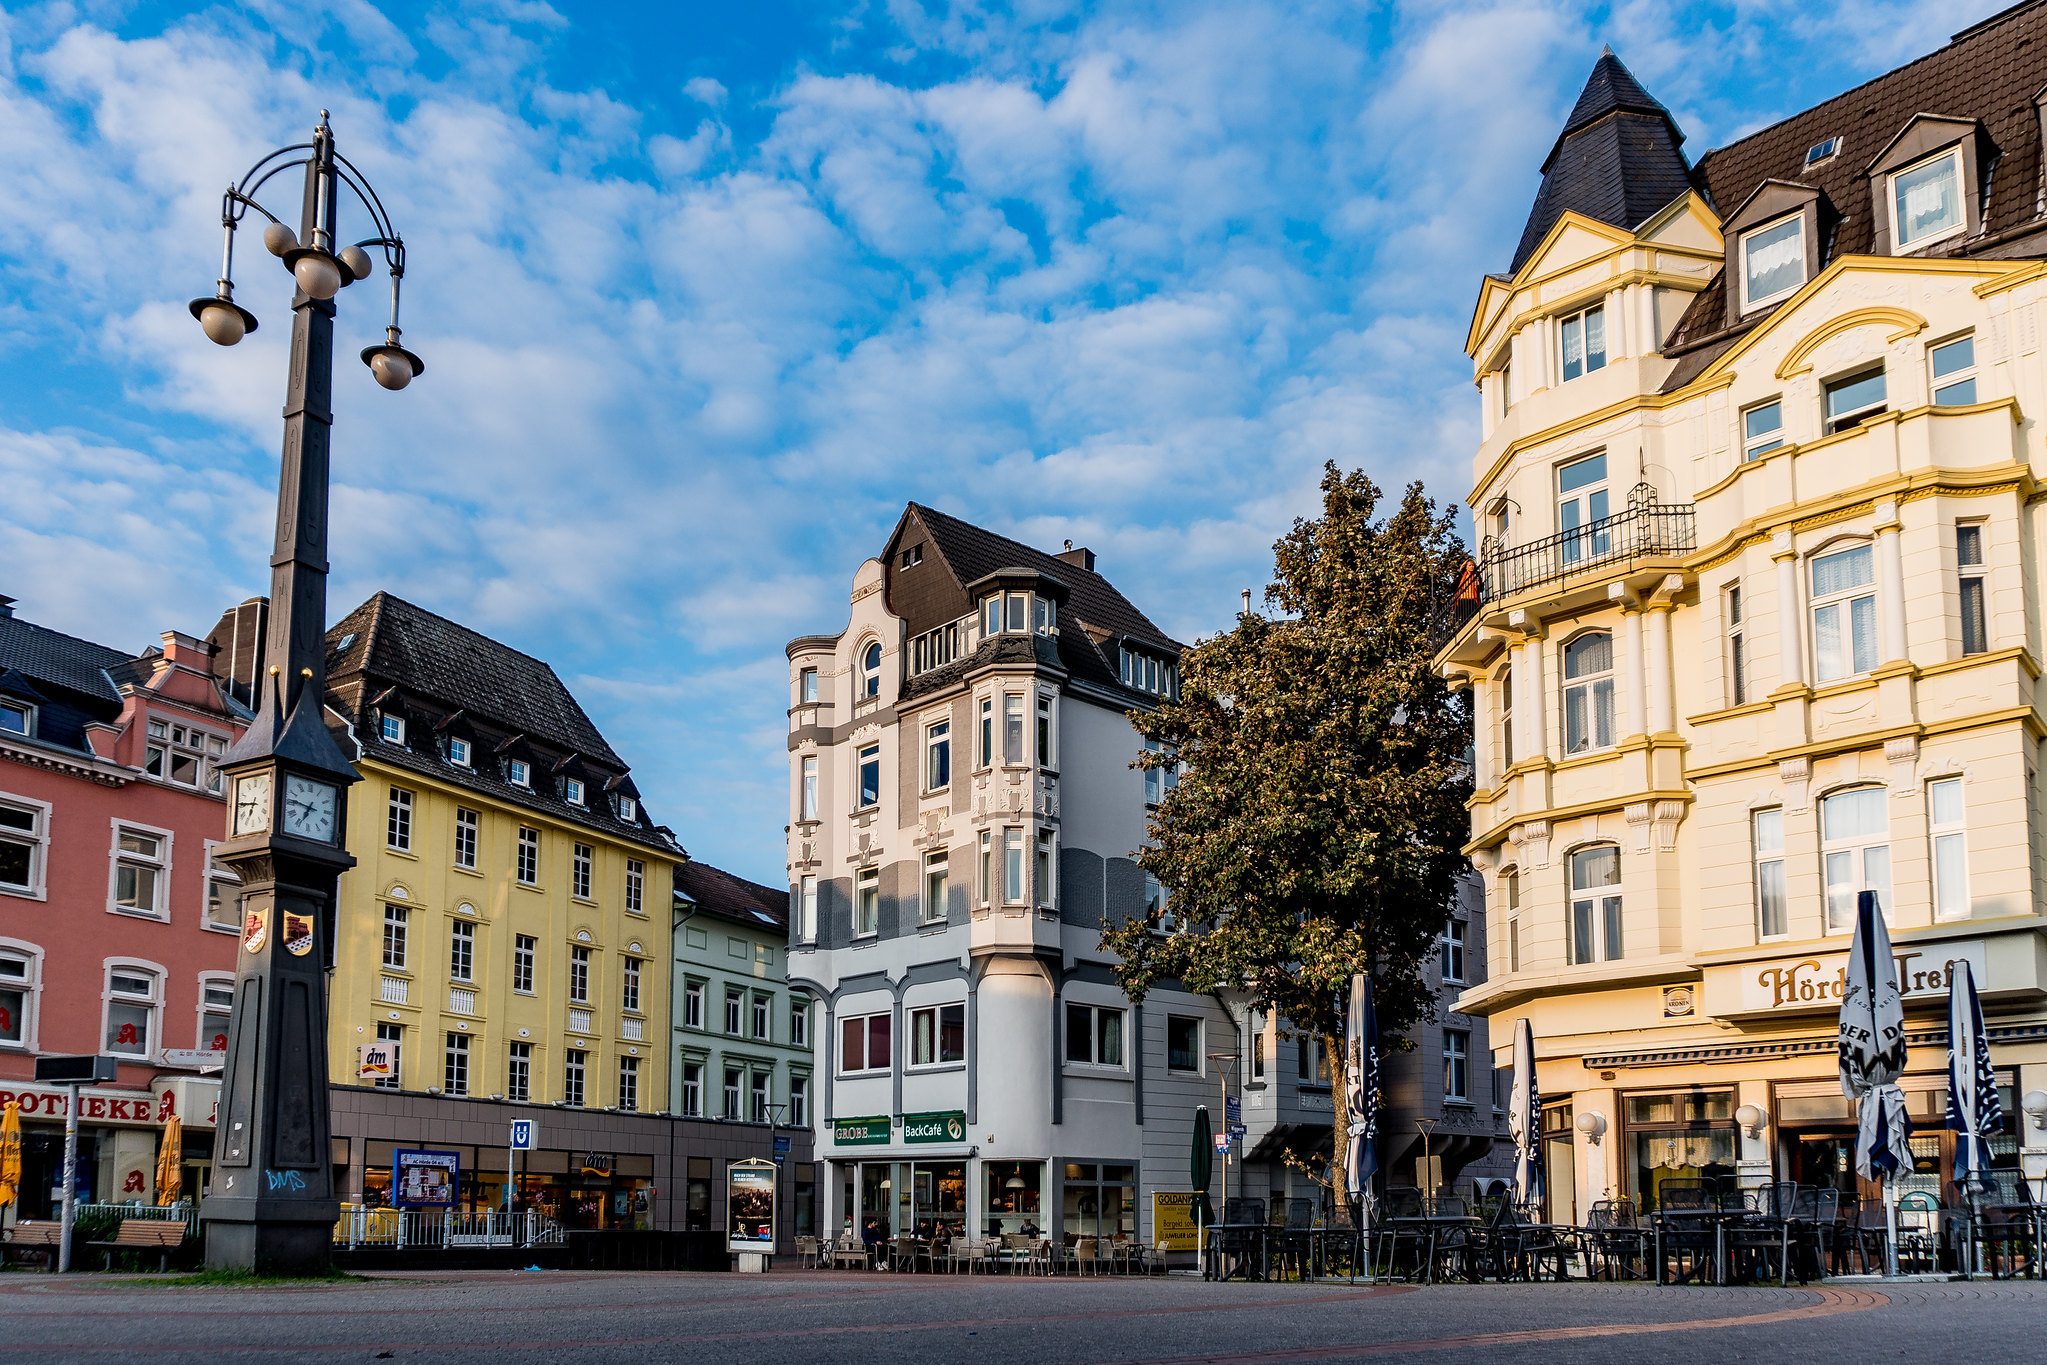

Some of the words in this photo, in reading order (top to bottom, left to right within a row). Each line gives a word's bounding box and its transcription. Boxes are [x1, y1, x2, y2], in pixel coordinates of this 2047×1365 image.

[1759, 959, 1845, 1008] Hörd
[367, 1048, 386, 1064] dm
[835, 1126, 868, 1140] GROBE
[905, 1124, 942, 1137] BackCafé
[586, 1151, 608, 1168] dm
